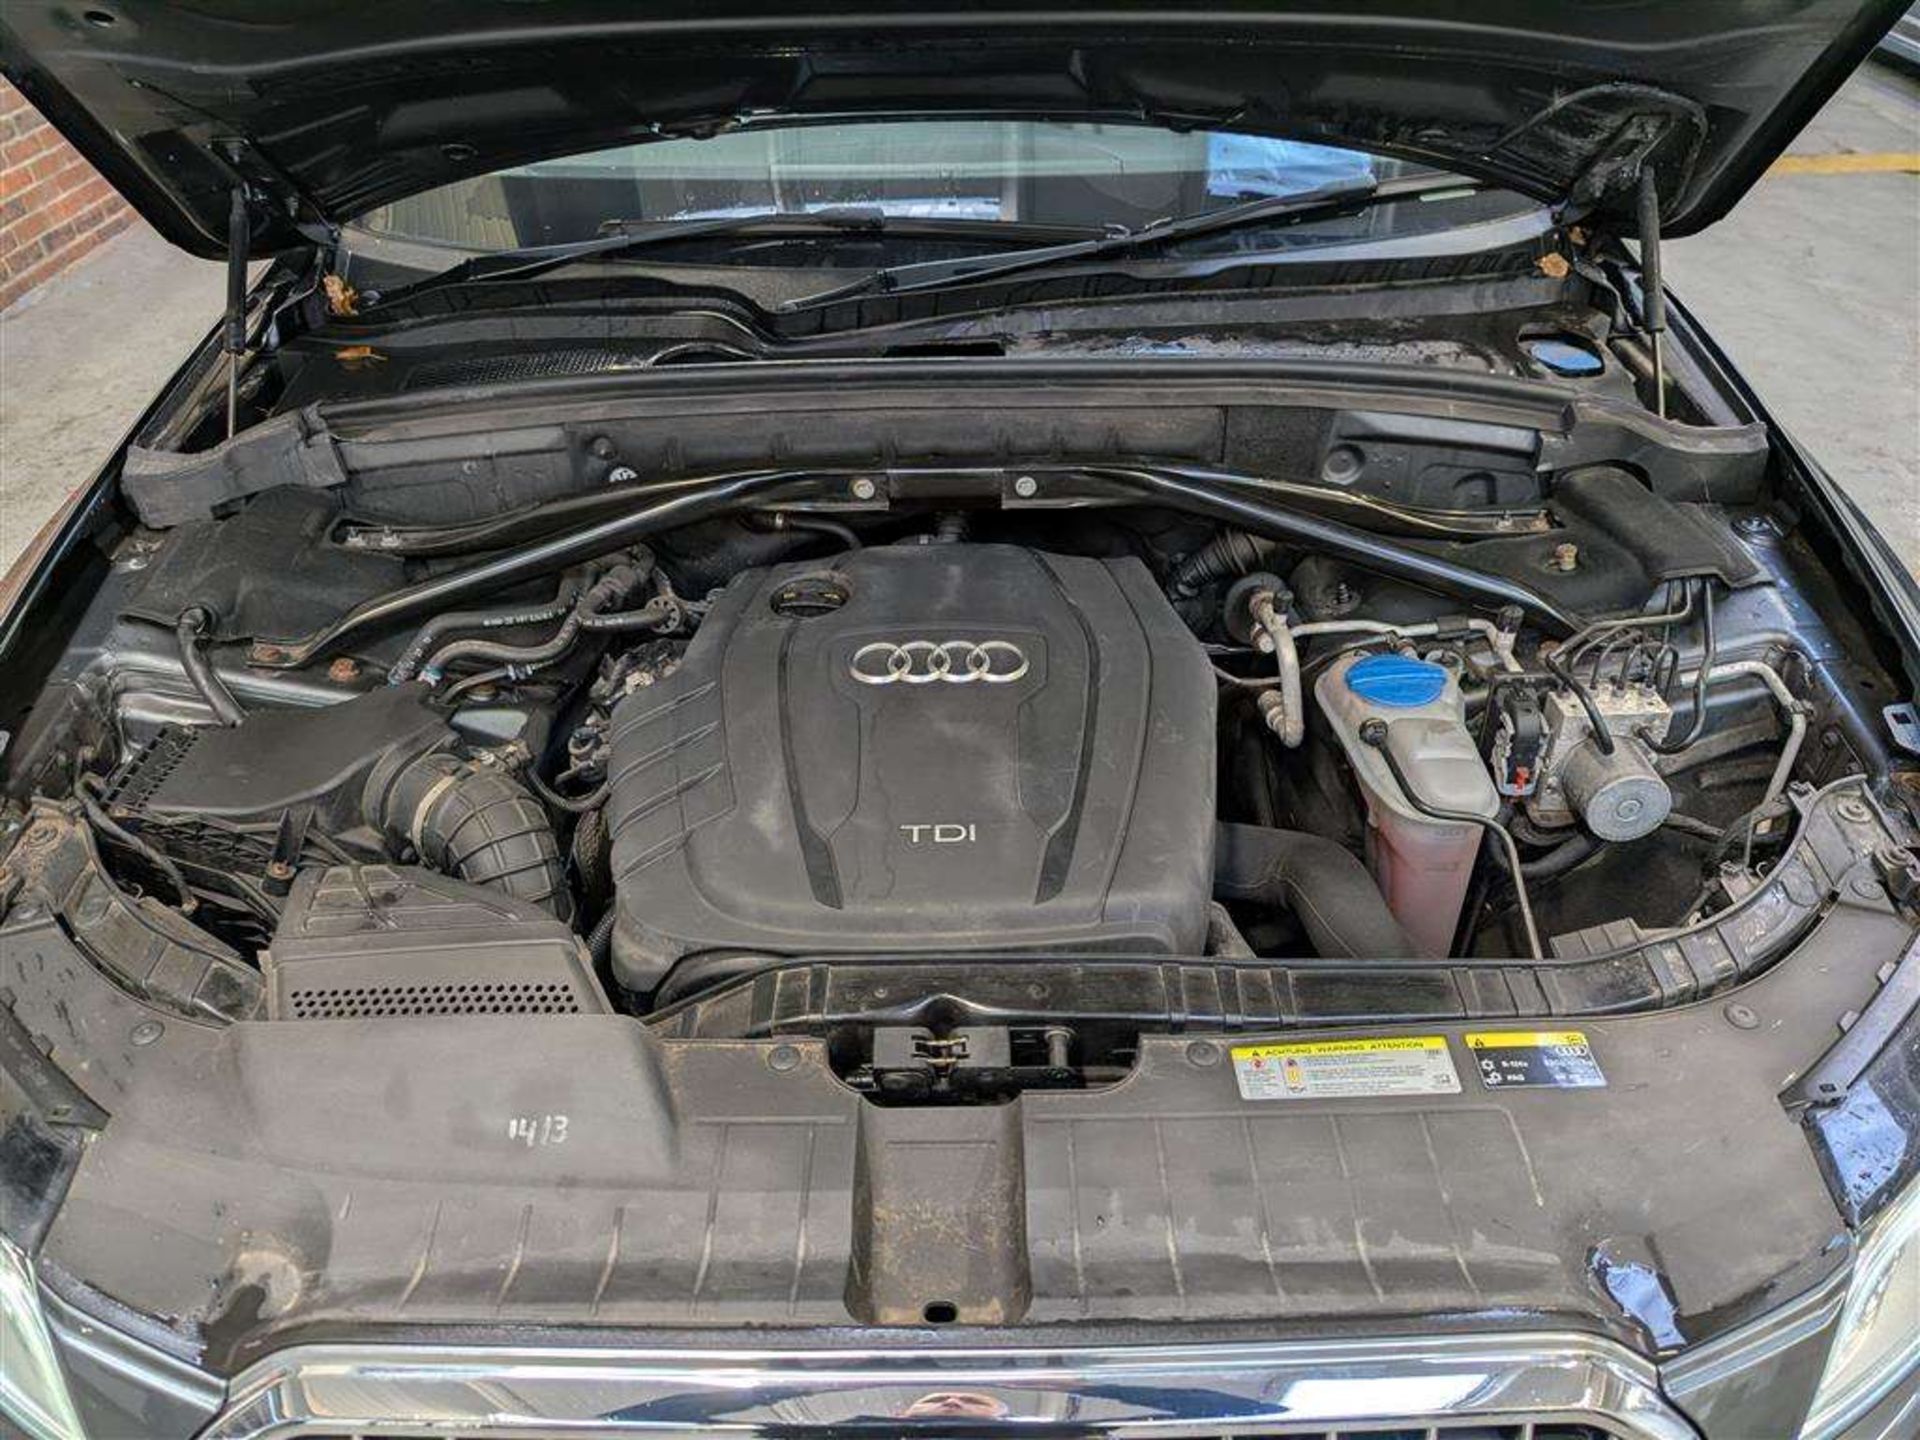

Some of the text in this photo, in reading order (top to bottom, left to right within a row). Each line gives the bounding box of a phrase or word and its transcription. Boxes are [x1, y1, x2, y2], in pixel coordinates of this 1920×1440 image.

[900, 824, 976, 842] TDI
[1264, 1041, 1425, 1056] ACHTUNG WARNING ATTENTION
